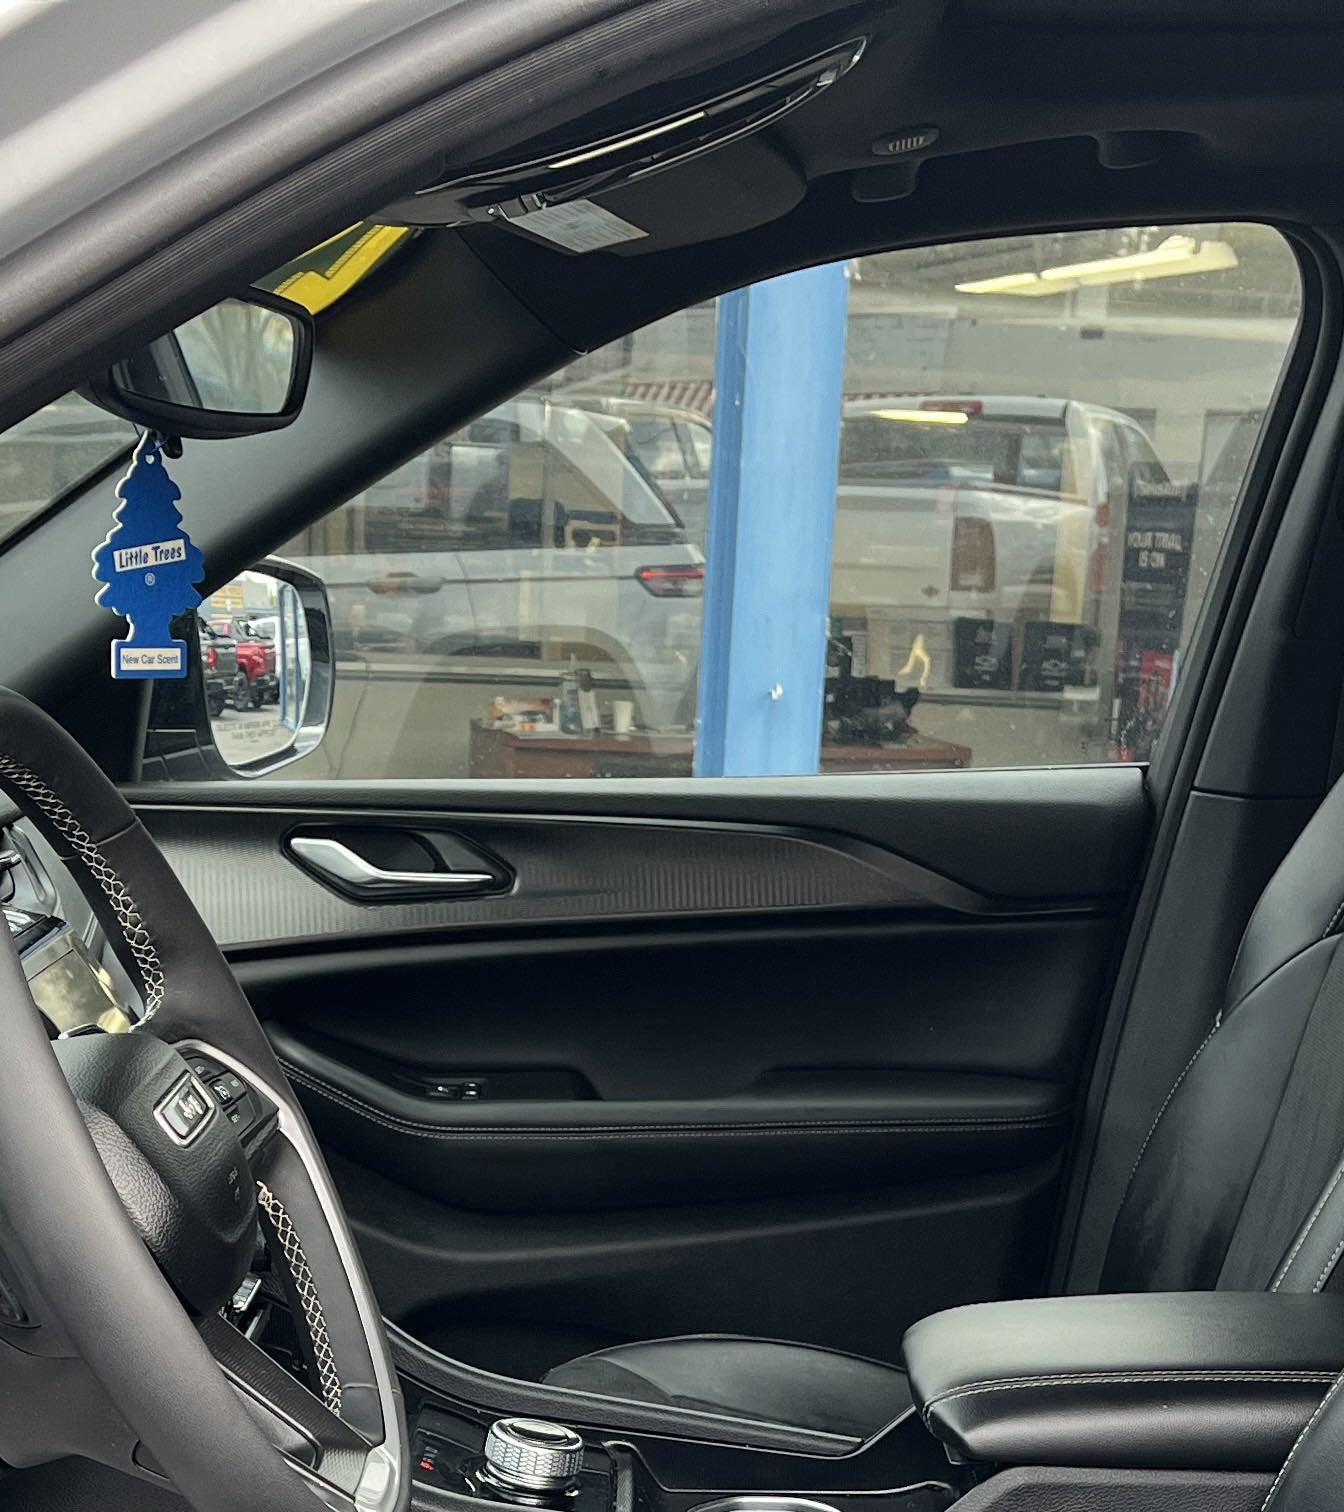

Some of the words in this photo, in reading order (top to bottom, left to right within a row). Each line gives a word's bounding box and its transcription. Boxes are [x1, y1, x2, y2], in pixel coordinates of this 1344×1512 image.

[119, 549, 149, 568] Little
[152, 545, 182, 562] Trees
[122, 655, 139, 665] New
[141, 654, 155, 665] Car
[157, 654, 178, 665] Scent
